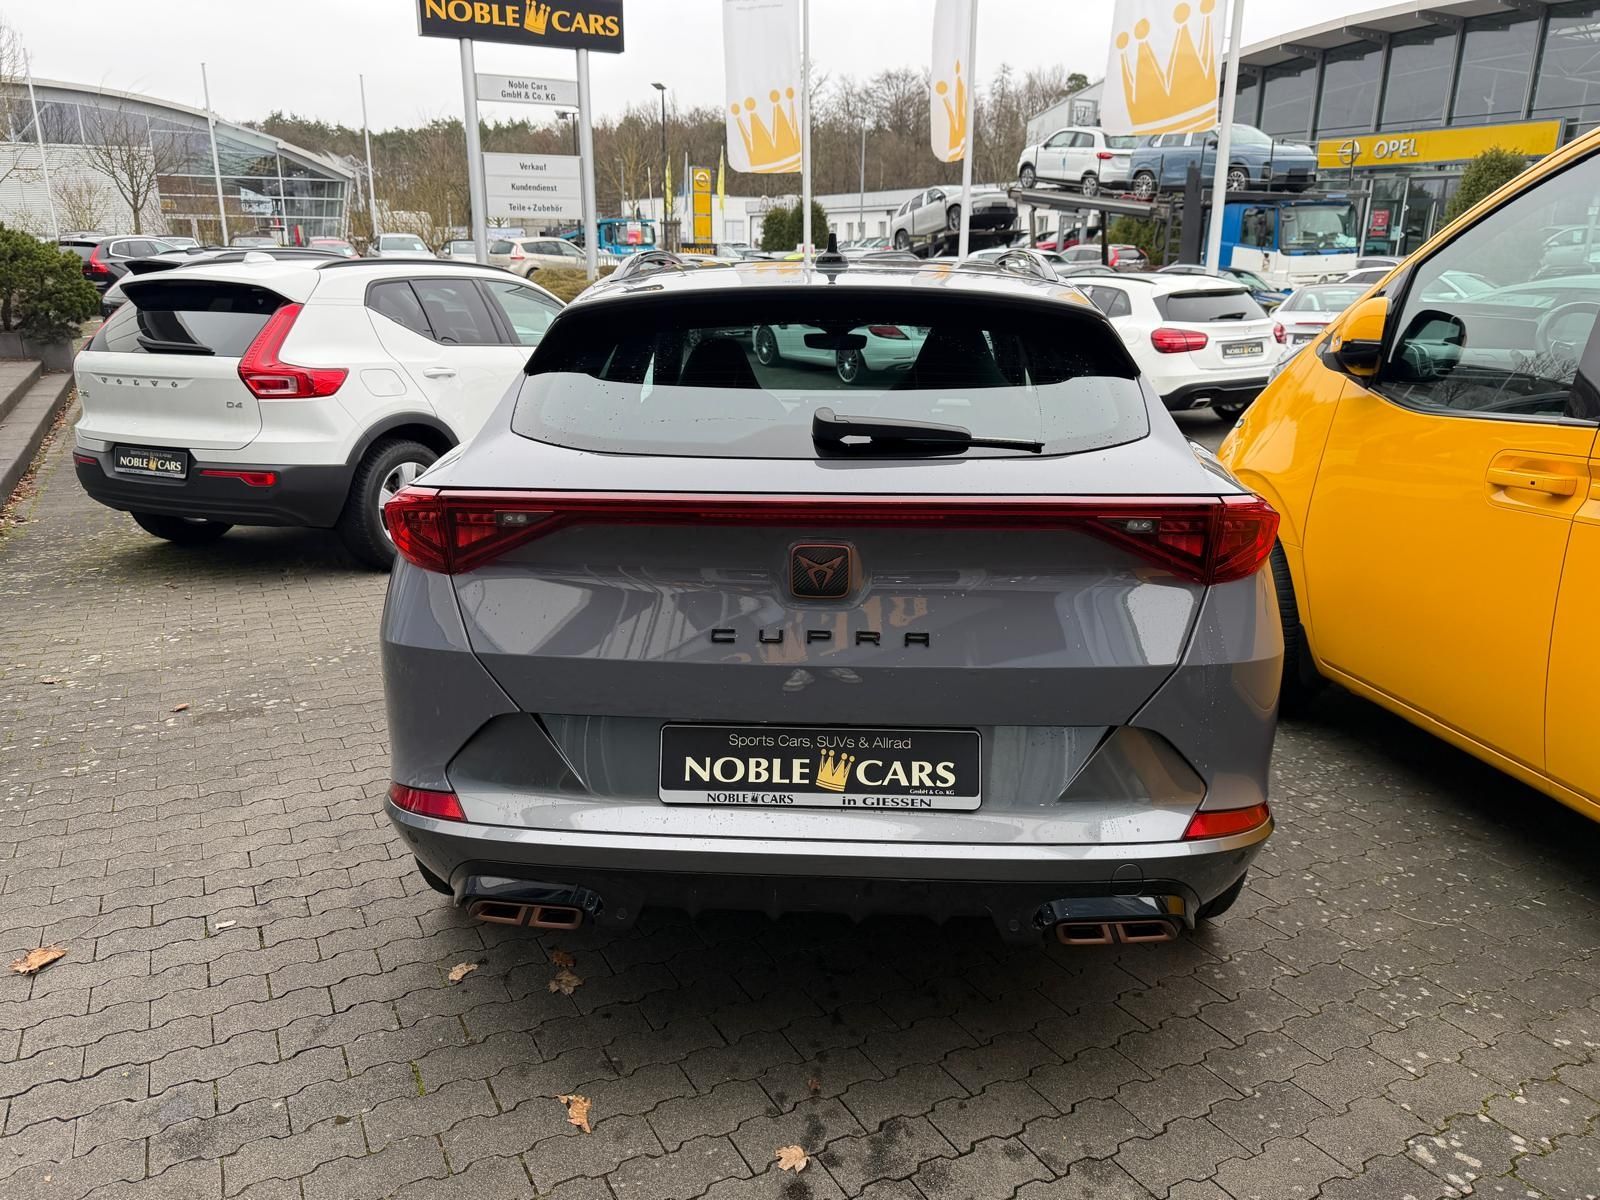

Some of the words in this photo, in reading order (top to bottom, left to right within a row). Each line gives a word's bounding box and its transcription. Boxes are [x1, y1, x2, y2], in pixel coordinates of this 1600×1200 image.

[425, 0, 520, 27] NOBLE
[551, 10, 620, 37] CARS
[508, 80, 529, 90] Noble
[531, 82, 548, 91] Cars
[501, 90, 522, 99] GmbH
[532, 92, 544, 101] Co.
[545, 93, 556, 101] KG
[1374, 138, 1419, 159] OPEL
[519, 162, 547, 171] Verkauf
[511, 183, 557, 192] Kundendienst
[101, 376, 178, 388] VOLVO
[226, 401, 243, 409] D4
[120, 456, 148, 467] NOBLE
[158, 460, 181, 471] CARS
[711, 629, 930, 648] CUPRA
[729, 733, 774, 747] Sports
[778, 735, 815, 749] Cars,
[816, 735, 855, 748] SUVs
[859, 736, 869, 748] &
[873, 736, 912, 749] Allrad
[684, 756, 810, 784] NOBLE
[856, 760, 956, 788] CARS
[707, 793, 749, 803] NOBLE
[760, 794, 794, 804] CARS
[842, 796, 857, 806] in
[862, 797, 932, 808] GIESSEN
